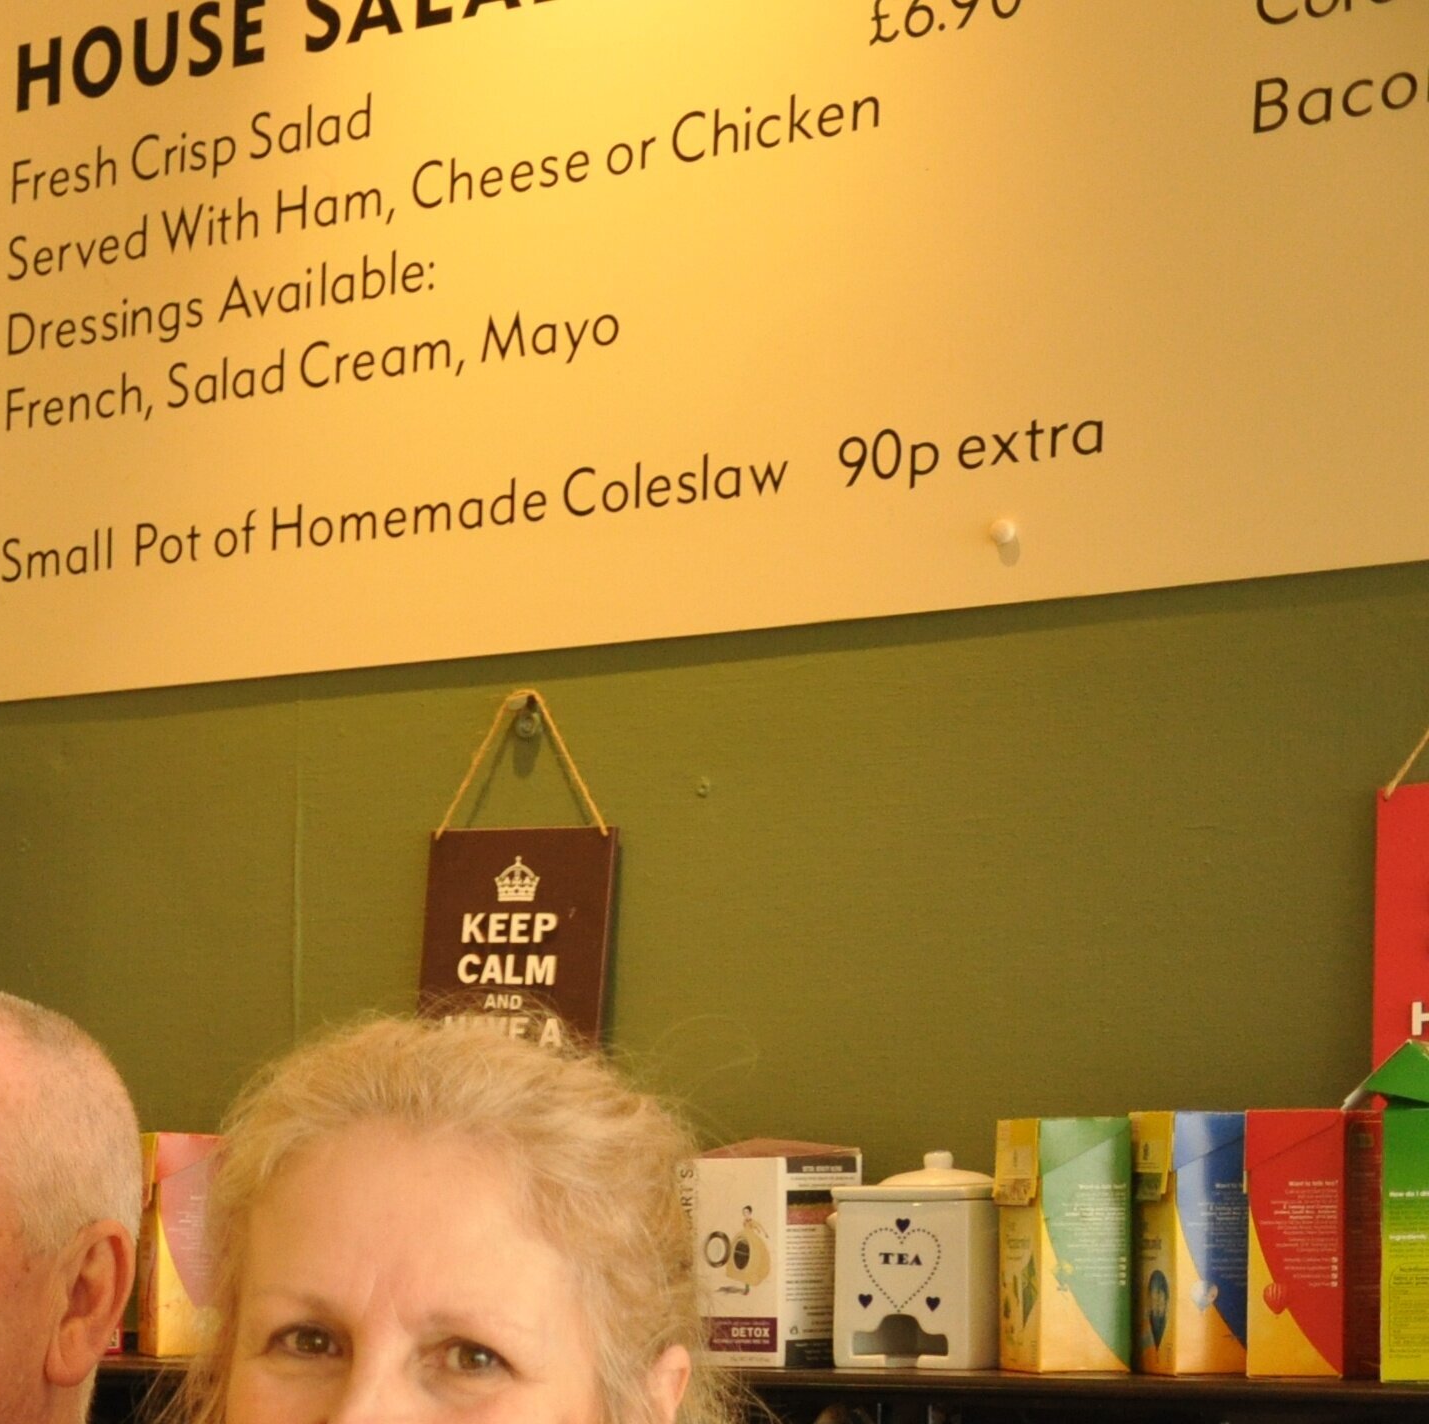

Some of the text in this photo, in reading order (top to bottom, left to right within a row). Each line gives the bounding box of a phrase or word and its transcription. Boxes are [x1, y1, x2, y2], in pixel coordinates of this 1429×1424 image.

[15, 0, 265, 112] HOUSE
[7, 94, 881, 280] Served With Ham, Cheese or Chicken
[12, 92, 373, 203] Fresh Crisp Salad
[6, 250, 436, 356] Dressings Available:
[5, 311, 619, 431] French, Salad Cream, Mayo
[2, 418, 1104, 582] Small Pot of Homemade Coleslaw 90p extra
[457, 954, 557, 986] CALM
[461, 912, 559, 944] KEEP
[484, 994, 522, 1010] AND
[879, 1252, 923, 1266] TEA
[731, 1327, 770, 1338] DETOX
